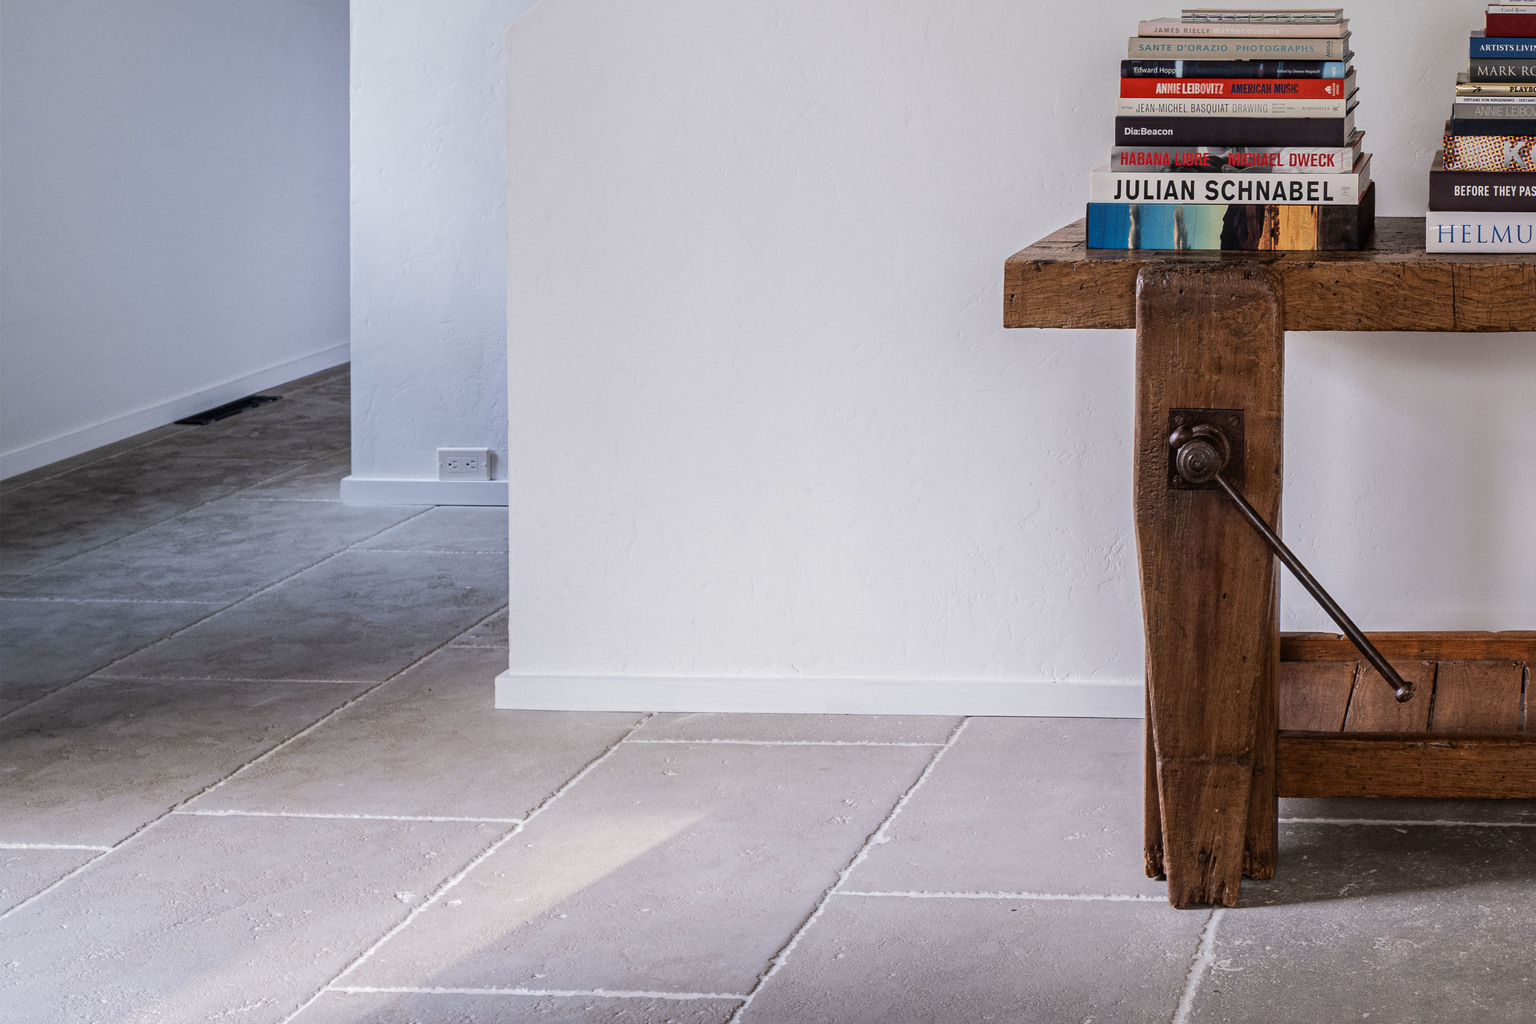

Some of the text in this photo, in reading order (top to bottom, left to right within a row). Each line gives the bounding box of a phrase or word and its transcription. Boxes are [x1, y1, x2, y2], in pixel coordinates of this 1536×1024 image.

[1177, 44, 1228, 52] D'ORAZIO
[1480, 44, 1514, 52] ARTISTS
[1477, 66, 1517, 76] MARK
[1156, 83, 1299, 94] ANNIE LEIBOVITZ AMERICAN MUSIC
[1136, 104, 1187, 113] JEAN-MICHEL
[1191, 104, 1229, 114] BASQUIAT
[1232, 104, 1268, 113] DRAWING
[1475, 106, 1504, 116] ANNIE
[1124, 127, 1173, 135] Dia:Beacon
[1121, 152, 1335, 167] HABANA LIBRE MICHAEL DWECK
[1114, 180, 1195, 200] JULIAN
[1205, 180, 1333, 201] SCHNABEL
[1454, 185, 1490, 196] BEFORE
[1493, 186, 1517, 197] THEY
